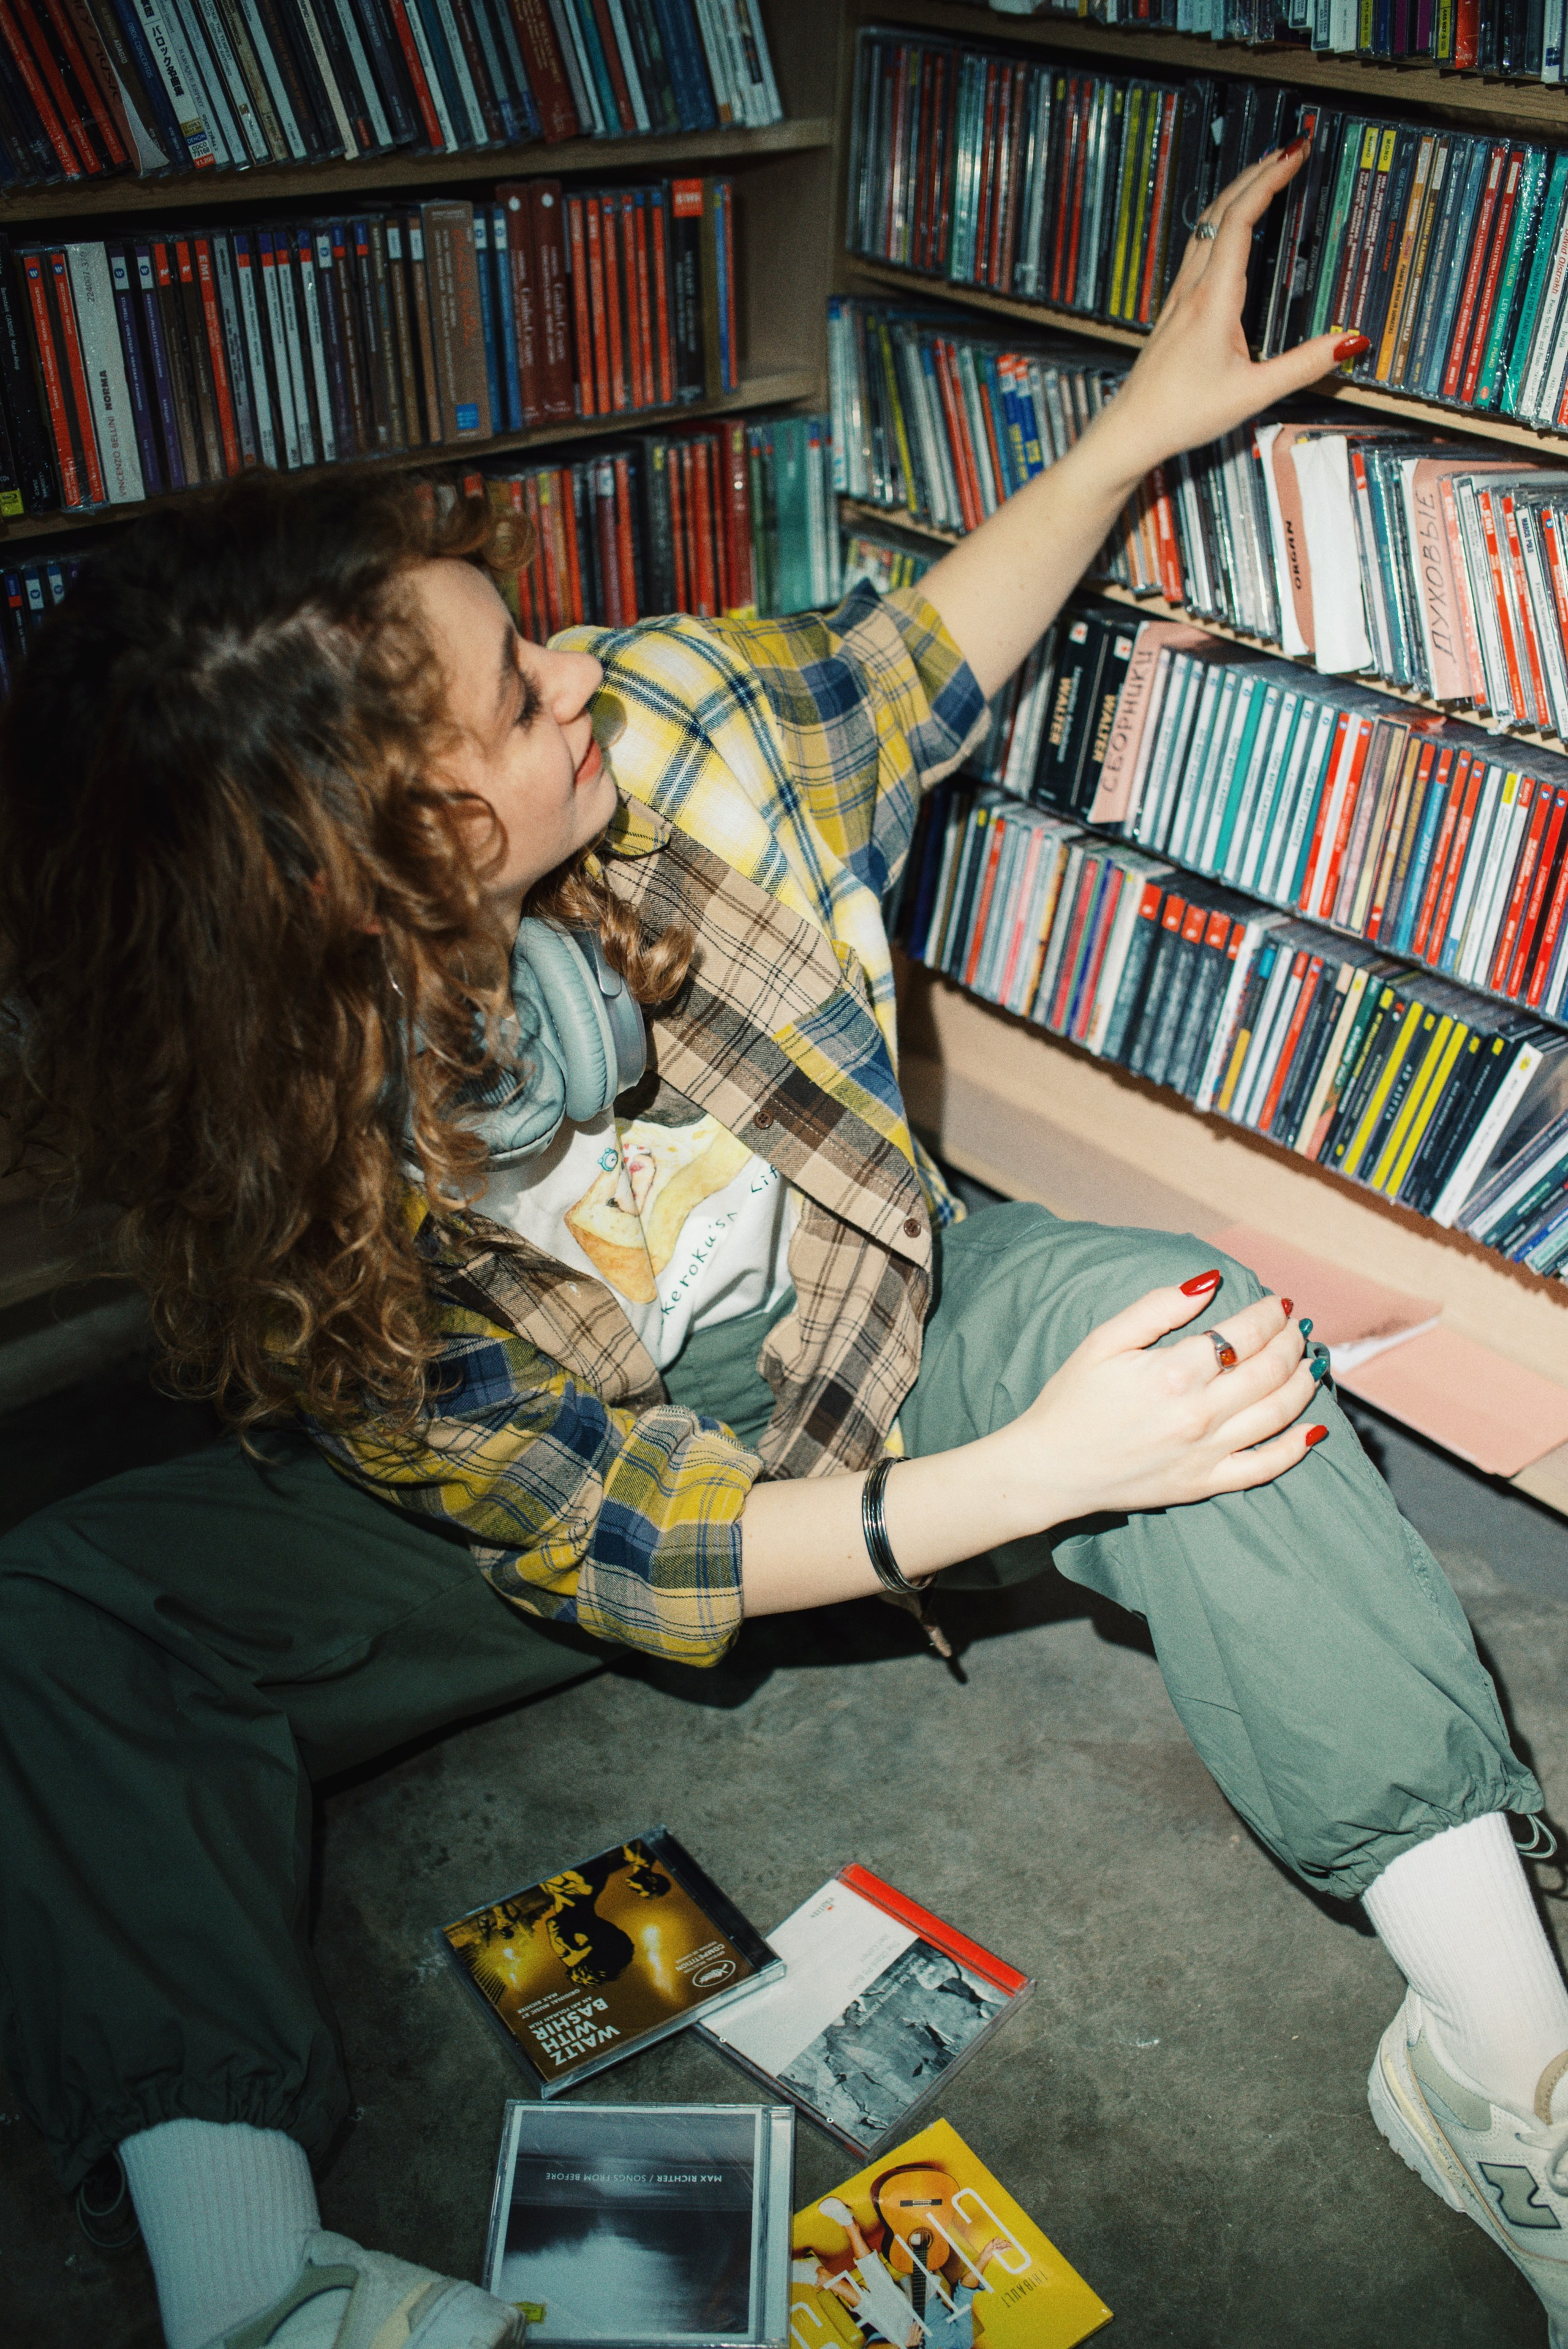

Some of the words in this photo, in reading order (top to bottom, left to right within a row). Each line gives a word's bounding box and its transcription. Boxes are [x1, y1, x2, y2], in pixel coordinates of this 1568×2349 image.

[100, 7, 117, 39] ALBINONI
[113, 38, 127, 64] ADAGIO
[219, 33, 232, 61] TEMPEST
[126, 21, 138, 40] OBOE
[134, 40, 153, 78] CONCERTOS
[87, 32, 124, 105] MUSIC
[176, 48, 195, 83] BAROQUE
[190, 83, 205, 108] ESPRIT
[72, 123, 87, 147] COMPACT
[83, 147, 96, 166] DISCS
[187, 133, 205, 144] DENON
[192, 141, 207, 151] COCO
[1382, 137, 1392, 162] MONO
[192, 146, 210, 157] 73168
[1396, 168, 1406, 186] GREAT
[1375, 192, 1384, 211] DAVID
[1391, 188, 1402, 219] VIOLINISTS
[1313, 214, 1324, 236] ELGAR
[1352, 208, 1363, 239] OISTRAKH
[1387, 221, 1396, 239] DAVID
[1423, 202, 1434, 235] D.OISTRAKH
[1498, 203, 1509, 235] D.OISTRAKH
[1541, 196, 1558, 239] BEETHOVEN
[1511, 219, 1527, 255] OISTRAKH
[198, 254, 210, 282] EMI
[1343, 270, 1352, 289] VIOLIN
[1398, 263, 1406, 283] PIANO
[1505, 262, 1517, 287] VIOLIN
[1528, 262, 1543, 295] SONATAS
[1551, 256, 1566, 295] Oistrakh
[1392, 289, 1401, 308] VIOLIN
[1411, 277, 1420, 296] VIOLIN
[0, 287, 10, 312] Bernstein
[119, 296, 129, 321] STILWELL
[1337, 291, 1348, 323] CONCERTO
[1354, 292, 1365, 328] CONCERTO
[1405, 296, 1416, 326] CONCERTOS
[1499, 297, 1509, 312] LEV
[1525, 296, 1535, 311] FOR
[4, 314, 15, 337] CANDIDE
[1387, 309, 1397, 334] SONATAS
[1474, 314, 1486, 344] BEETHOVEN
[1493, 313, 1506, 340] OBORIN
[1520, 312, 1531, 334] PIANO
[9, 339, 18, 355] Marin
[1516, 335, 1526, 350] AND
[1557, 330, 1568, 349] Dvořák
[12, 355, 21, 370] Alsop
[1487, 346, 1498, 369] PIANO
[1510, 352, 1523, 375] VIOLIN
[99, 370, 114, 410] NORMA
[106, 415, 120, 448] BELLINI
[112, 451, 128, 496] VINCENZO
[1482, 508, 1494, 535] EMI
[1505, 511, 1517, 538] EMI
[1520, 518, 1531, 538] MARCO
[1525, 538, 1534, 554] POLO
[1414, 491, 1457, 666] ДУХОВЫЕ
[1533, 582, 1545, 604] French
[1538, 606, 1553, 642] Saxophone
[1546, 644, 1559, 676] Concertos
[1049, 677, 1072, 746] WALTER
[1103, 649, 1154, 793] СБОРНИКИ
[1093, 694, 1116, 763] WALTER
[674, 1942, 725, 1972] COMPETITION
[897, 1972, 910, 1985] for
[542, 1991, 558, 2002] MAX
[550, 1987, 581, 2005] ORIGINAL
[570, 2000, 582, 2010] ARI
[878, 1980, 902, 2005] Johnny
[516, 1997, 543, 2015] RICHTER
[529, 2002, 550, 2015] MUSIC
[530, 1994, 609, 2043] BASHIR
[854, 2000, 882, 2028] Johnson
[528, 2018, 543, 2030] FILM
[540, 2016, 598, 2055] WITH
[548, 2021, 620, 2067] WALTZ
[699, 2174, 723, 2182] MAX
[1001, 2269, 1048, 2308] THIBAULT
